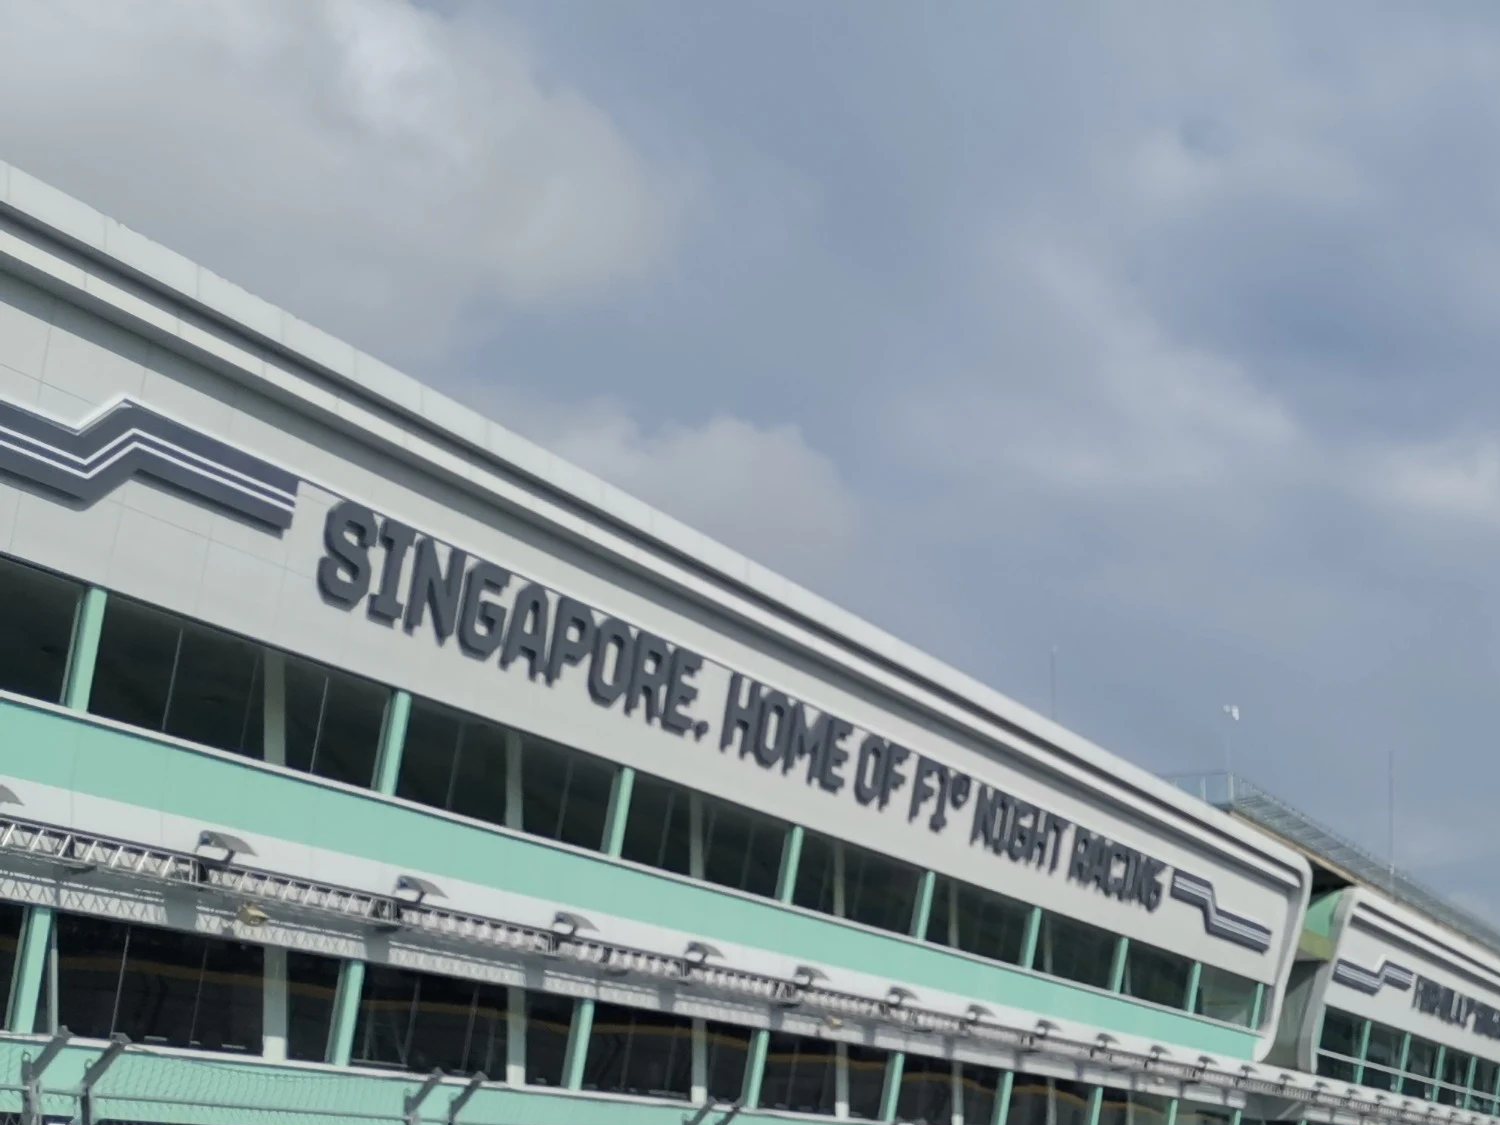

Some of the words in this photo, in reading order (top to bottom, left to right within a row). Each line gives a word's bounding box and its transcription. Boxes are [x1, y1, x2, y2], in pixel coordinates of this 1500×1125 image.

[719, 671, 854, 794] HOME
[854, 732, 911, 812] OF
[969, 783, 1074, 877] NIGHT
[1066, 823, 1169, 913] RACING
